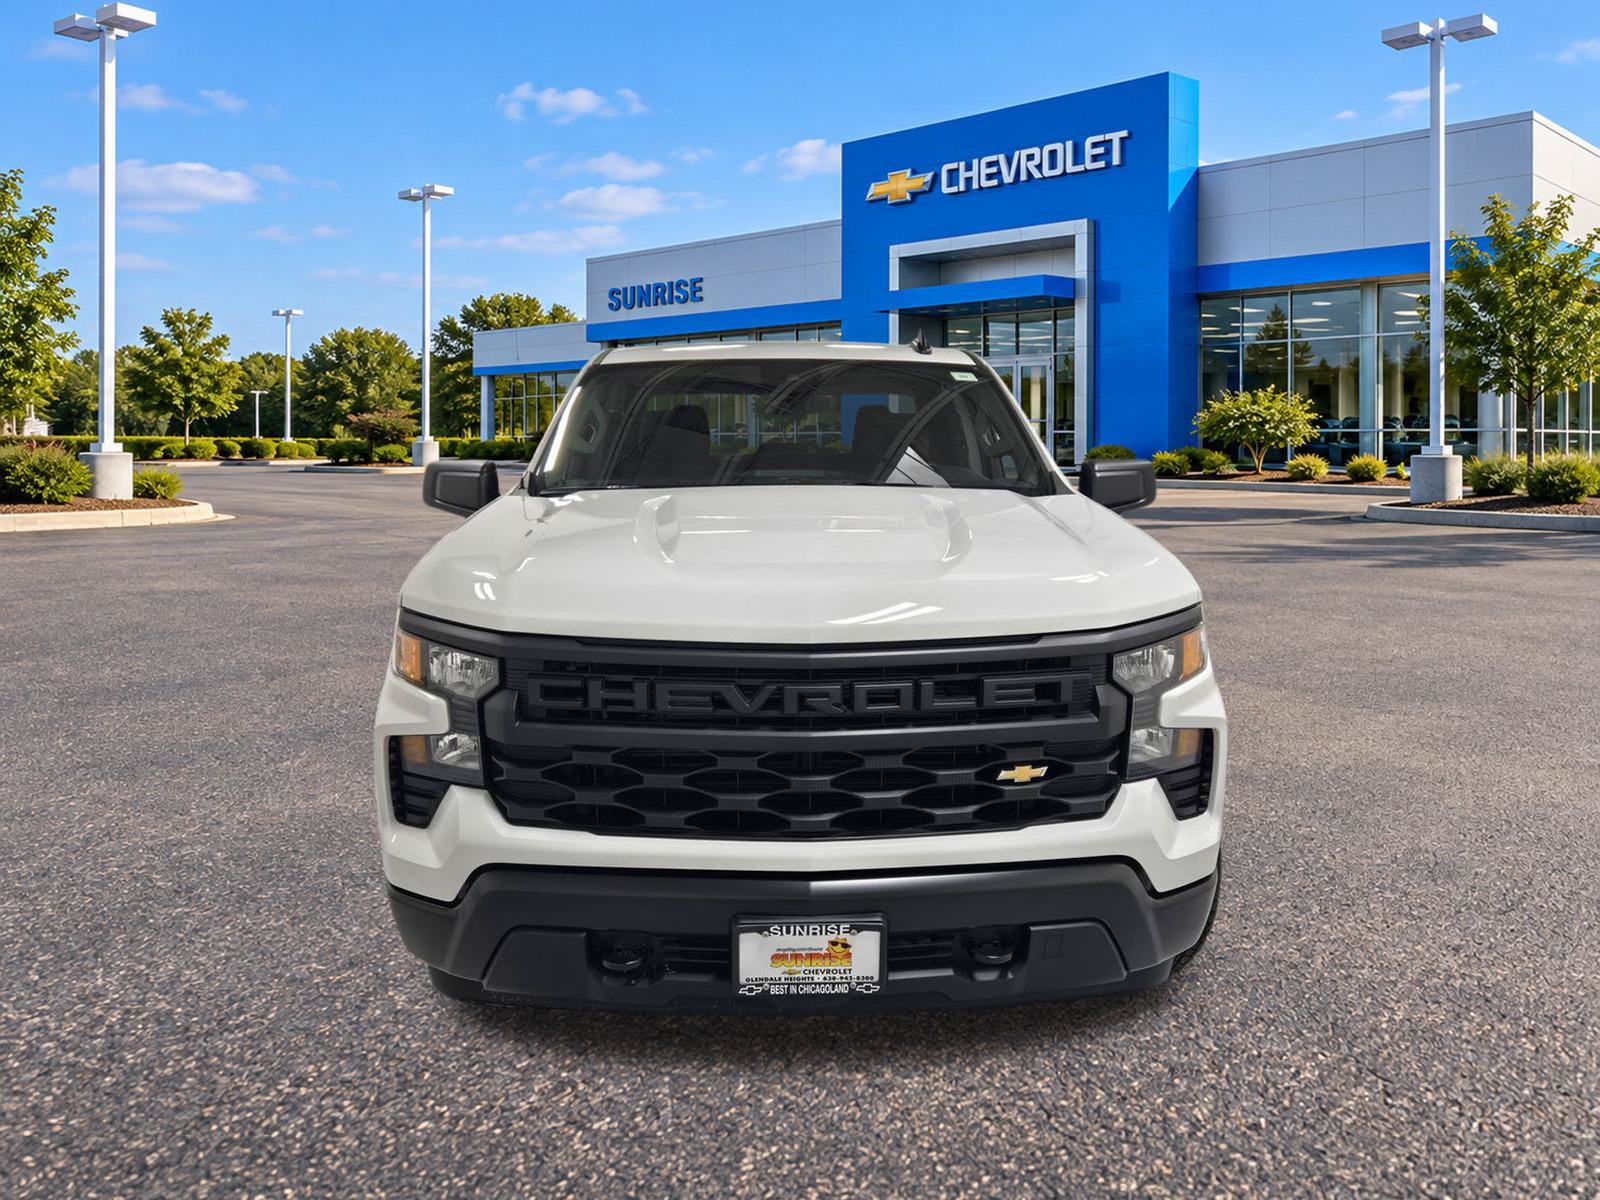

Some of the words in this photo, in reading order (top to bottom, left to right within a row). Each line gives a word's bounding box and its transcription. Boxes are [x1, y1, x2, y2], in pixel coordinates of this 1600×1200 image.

[941, 130, 1128, 194] CHEVROLET
[608, 277, 704, 312] SUNRISE
[528, 670, 1092, 716] CHEVROLET
[769, 924, 850, 937] SUNRISE
[769, 952, 853, 968] SUNRISE
[770, 984, 789, 995] BEST
[789, 984, 798, 994] IN
[798, 983, 850, 994] CHICAGOLAND
